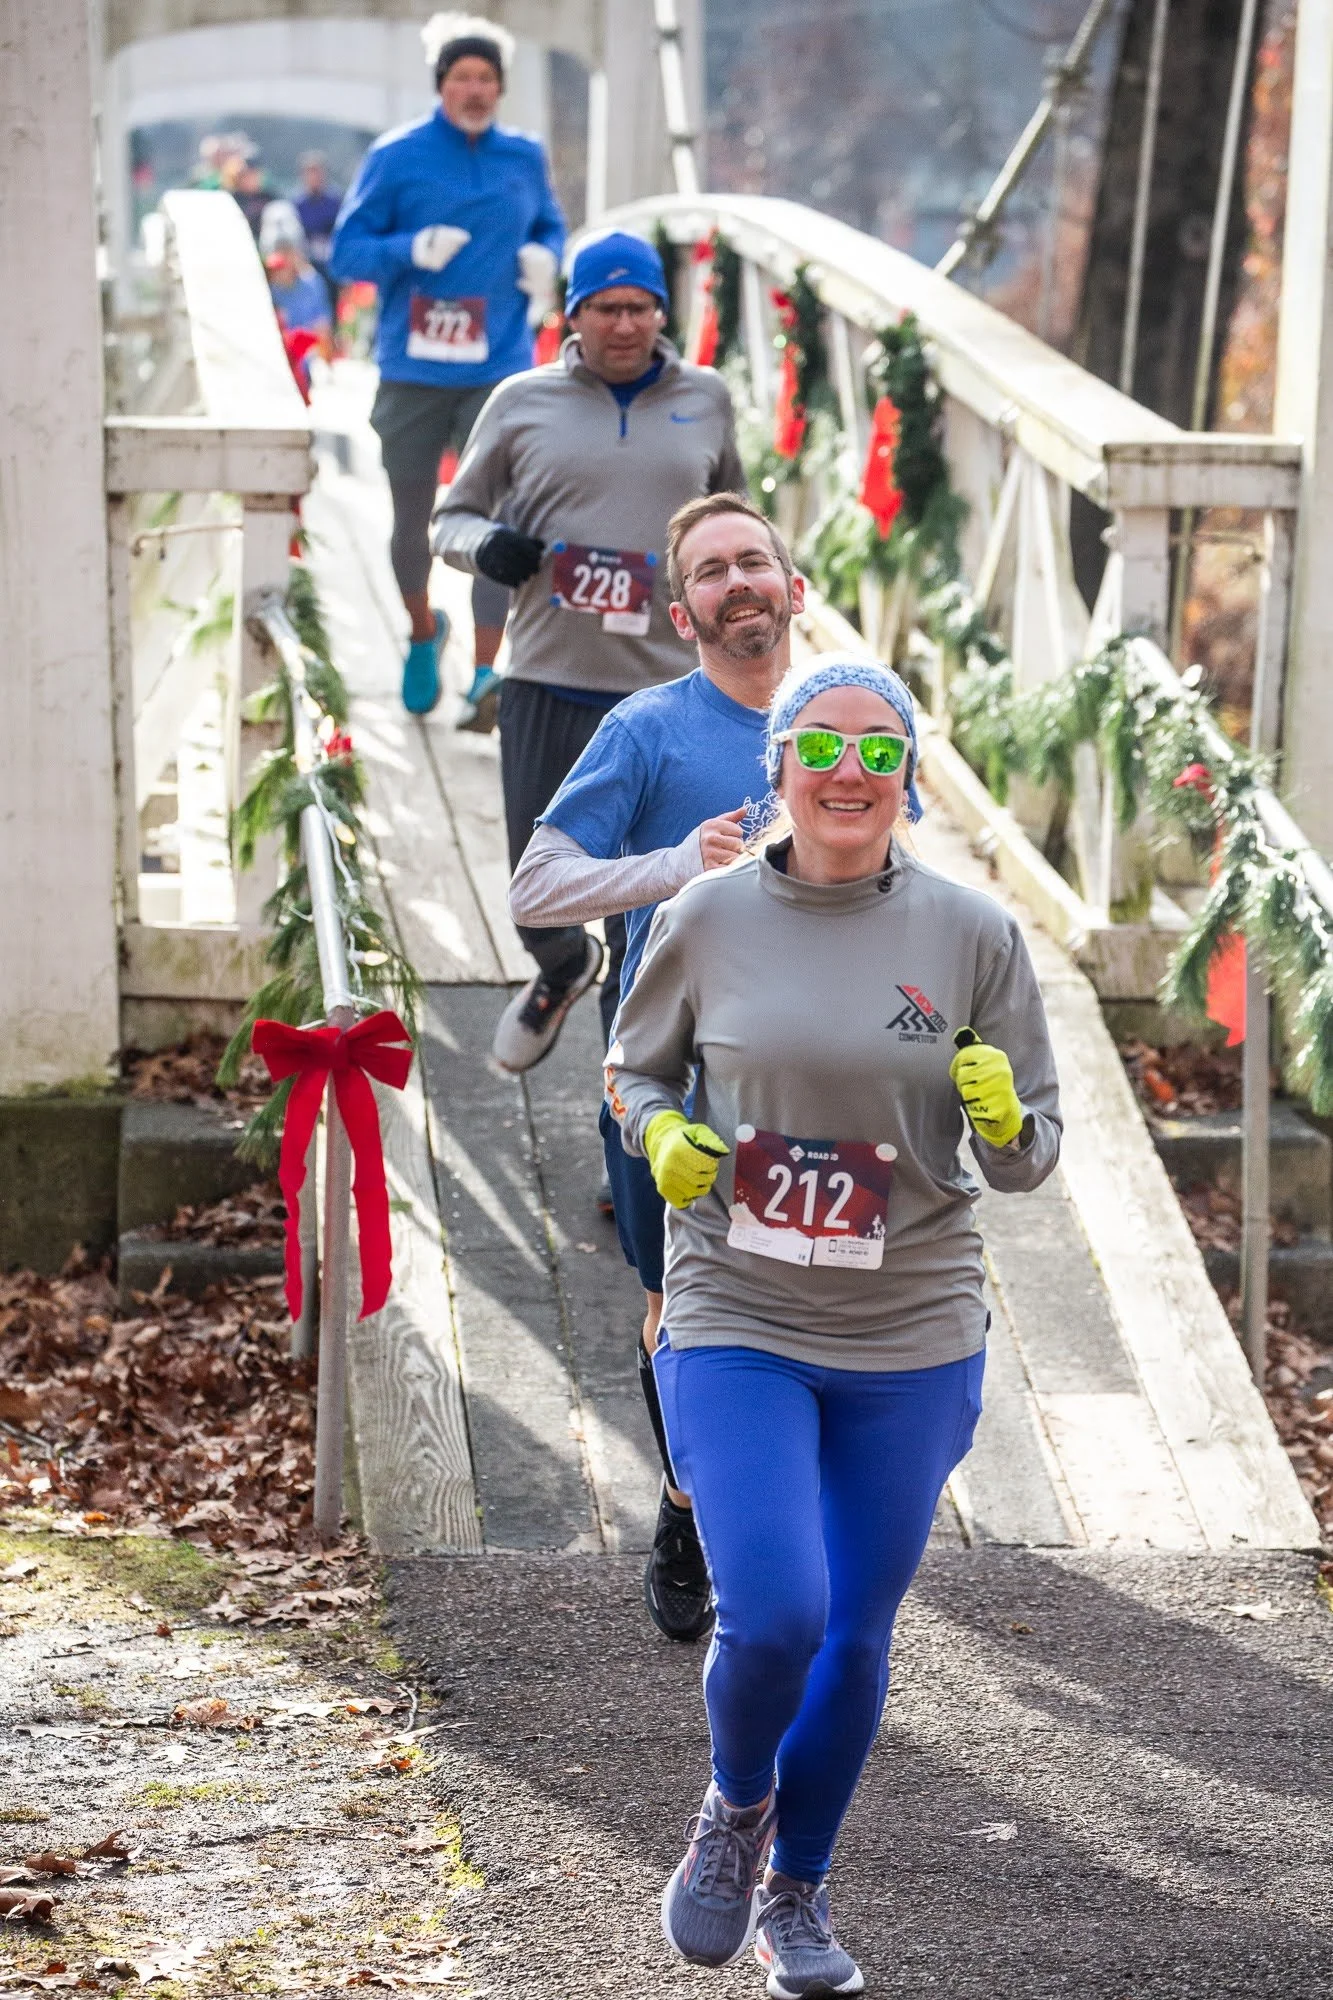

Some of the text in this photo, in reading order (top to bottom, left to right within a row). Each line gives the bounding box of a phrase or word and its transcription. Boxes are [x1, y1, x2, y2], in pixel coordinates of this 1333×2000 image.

[572, 564, 632, 609] 228
[807, 1151, 829, 1160] ROAD
[763, 1164, 854, 1230] 212
